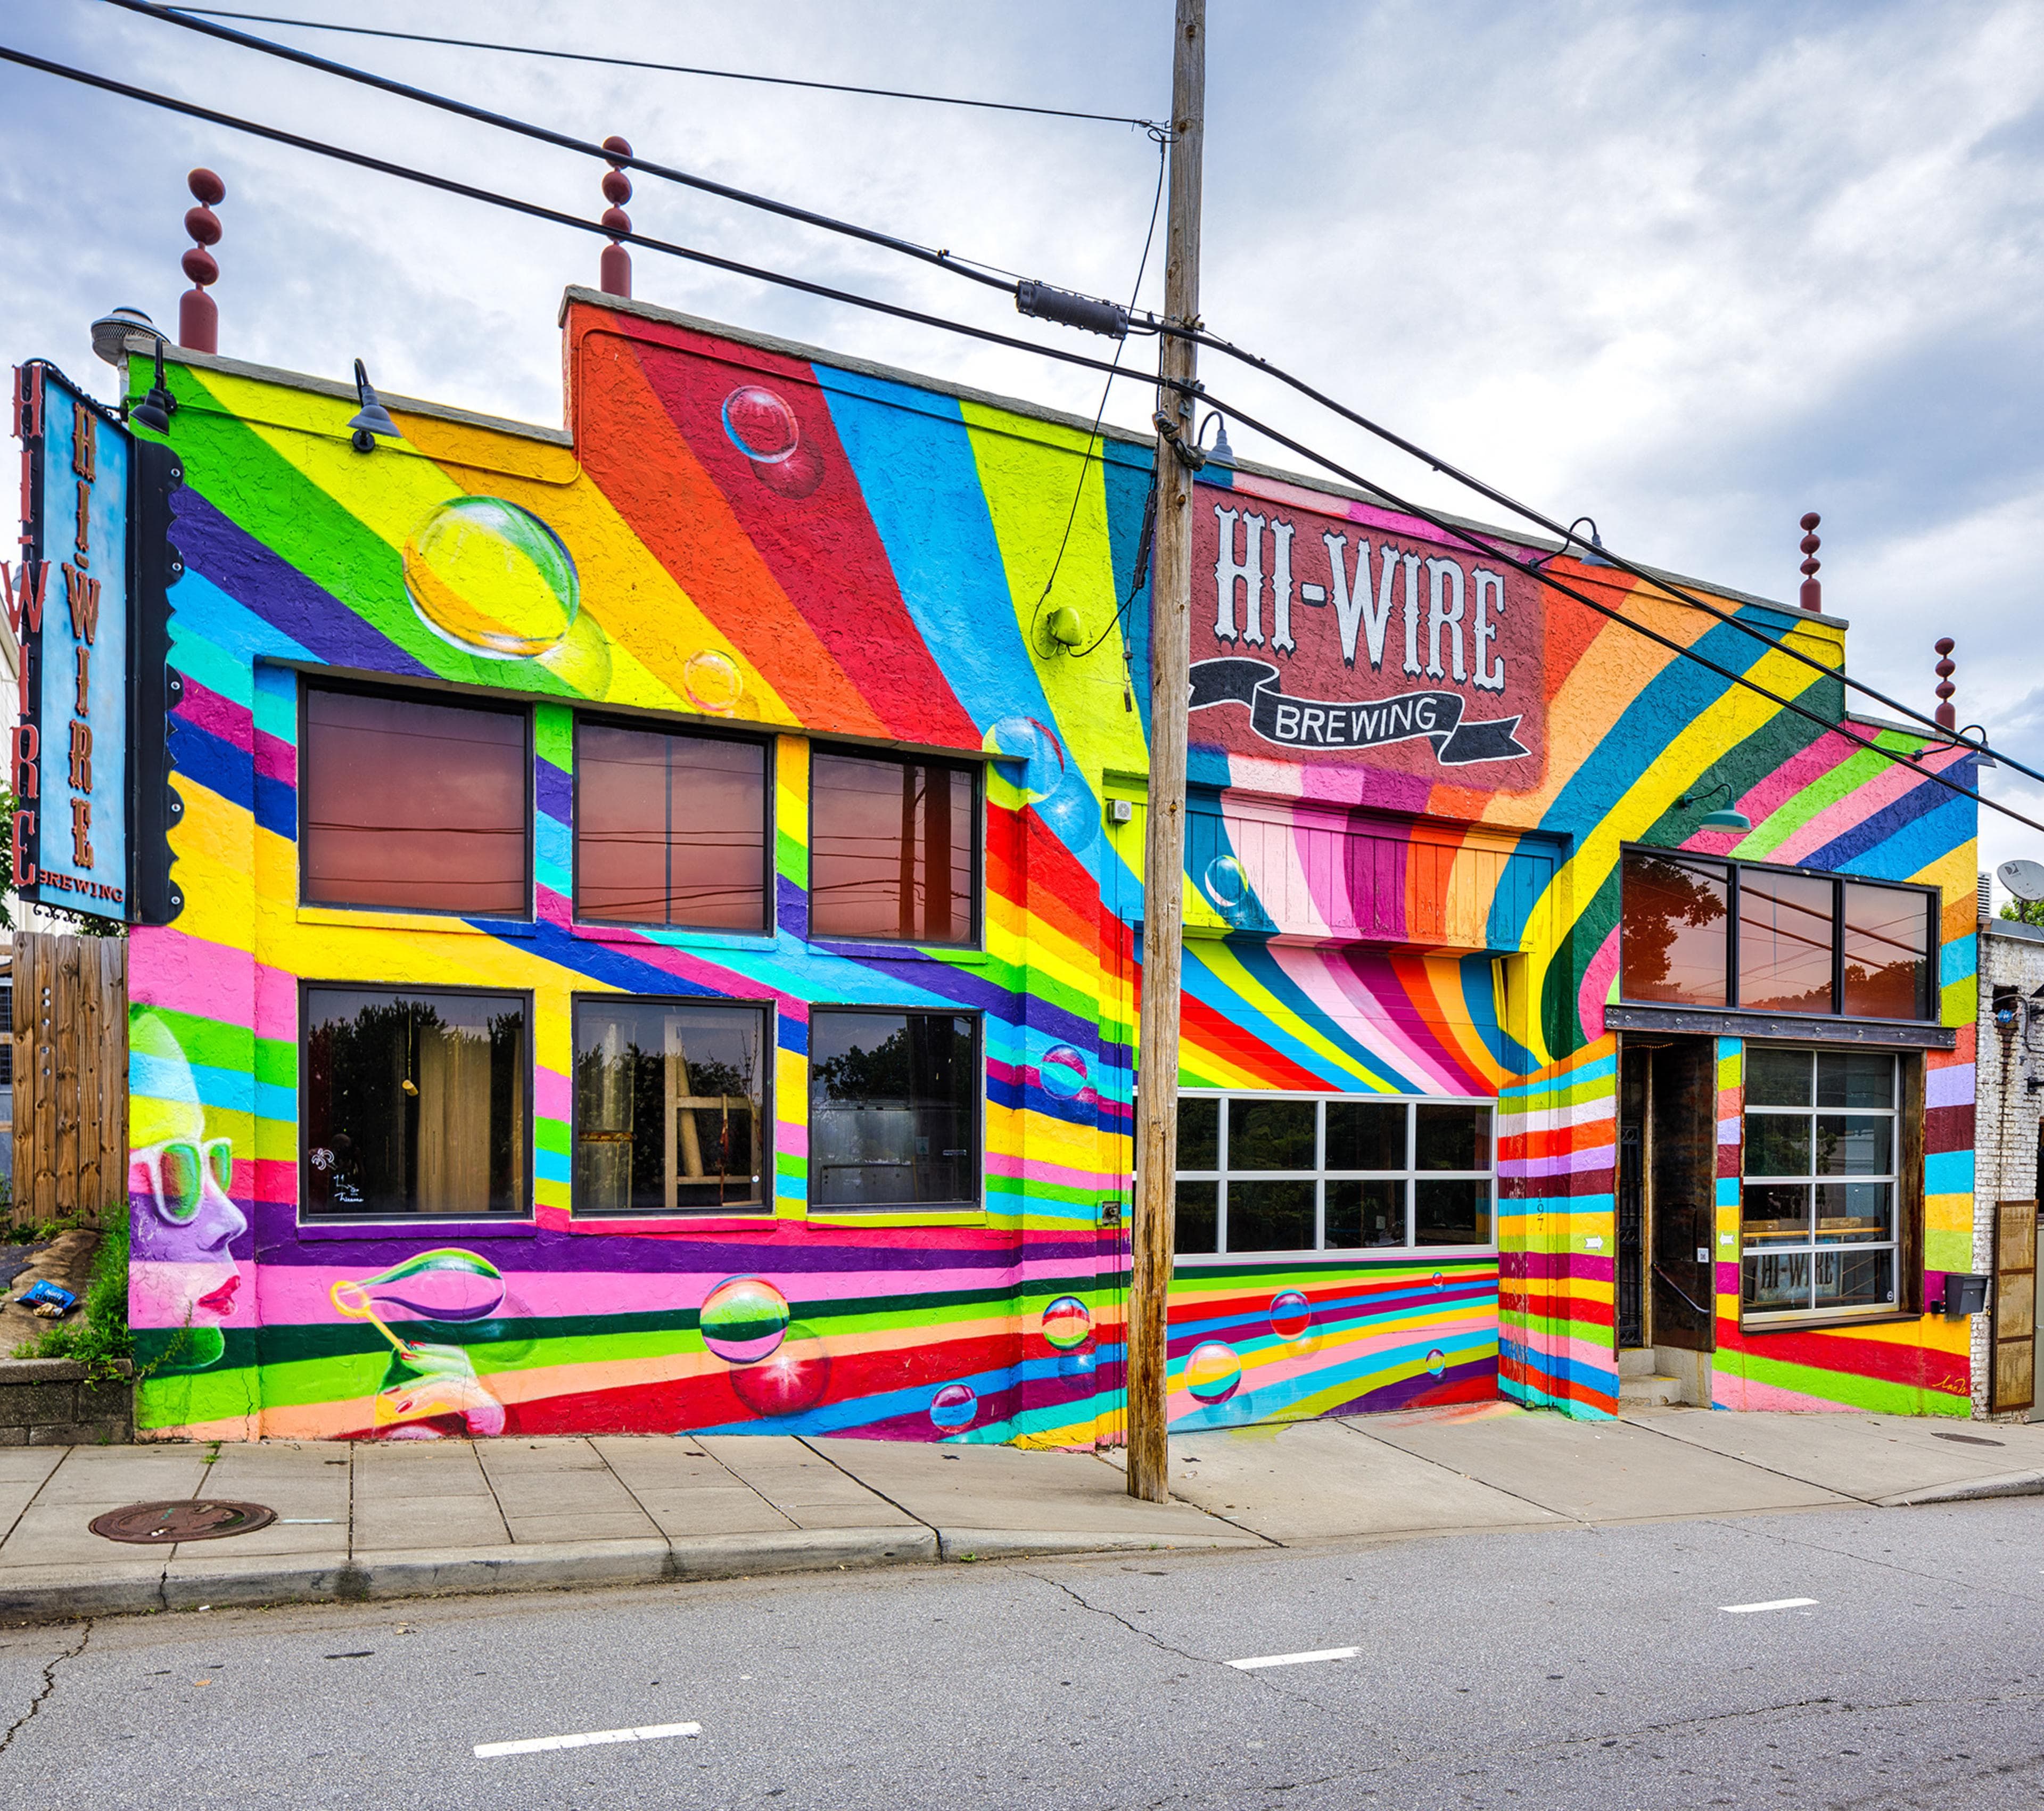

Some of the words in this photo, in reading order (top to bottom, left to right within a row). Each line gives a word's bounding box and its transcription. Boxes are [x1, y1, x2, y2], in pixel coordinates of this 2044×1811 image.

[0, 365, 46, 887] HI-WIRE
[62, 401, 101, 870] HI-WIRE
[1214, 503, 1505, 696] HI-WIRE
[1276, 697, 1438, 743] BREWING
